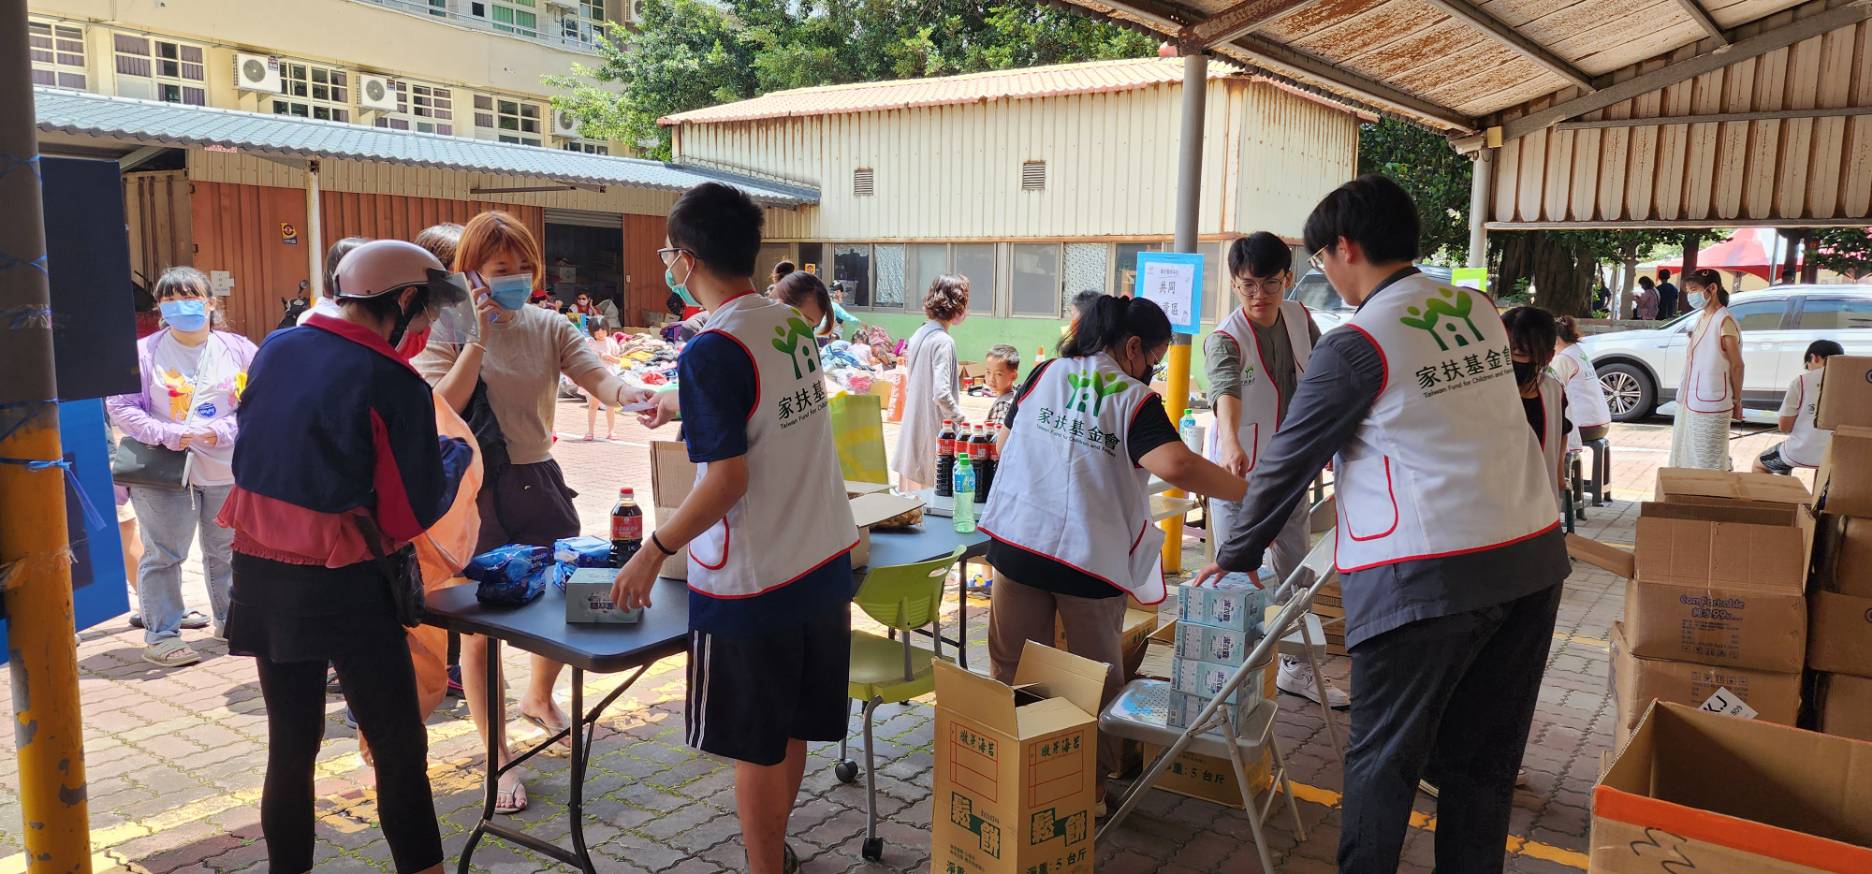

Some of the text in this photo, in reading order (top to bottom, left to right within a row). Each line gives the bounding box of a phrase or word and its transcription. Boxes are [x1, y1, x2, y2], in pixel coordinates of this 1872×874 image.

[1423, 387, 1448, 399] Taiwan
[1448, 381, 1463, 392] Fund
[1463, 379, 1471, 388] for
[1037, 406, 1121, 451] 家扶基金會
[951, 791, 1000, 859] 鬆餅
[1031, 807, 1087, 847] 鬆餅
